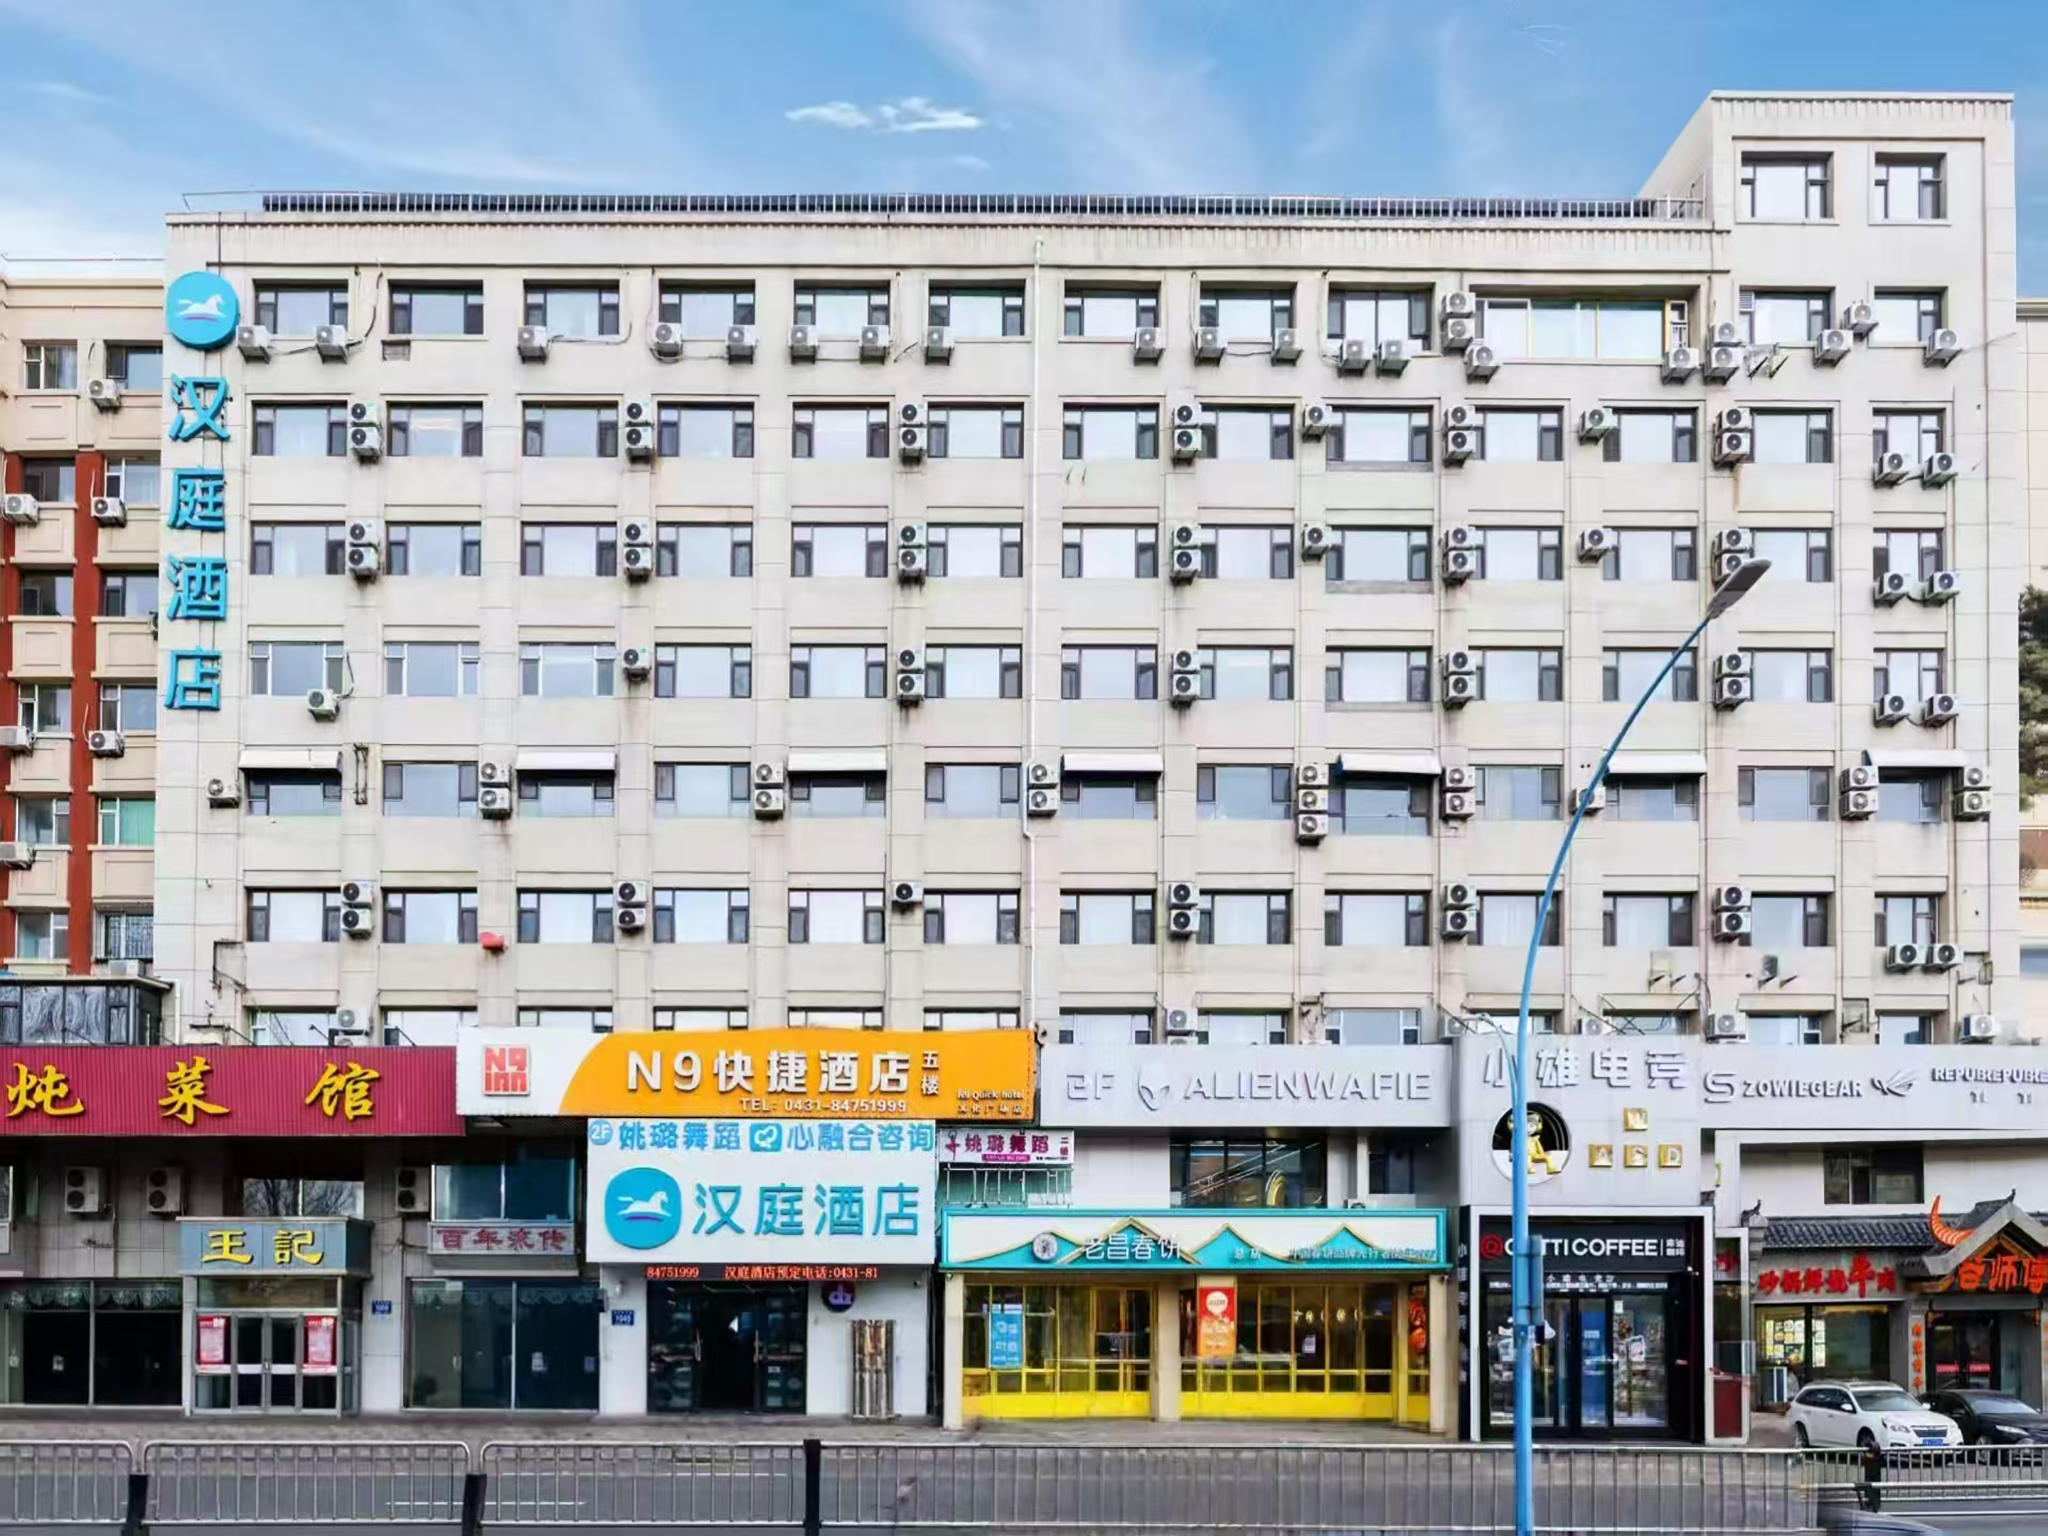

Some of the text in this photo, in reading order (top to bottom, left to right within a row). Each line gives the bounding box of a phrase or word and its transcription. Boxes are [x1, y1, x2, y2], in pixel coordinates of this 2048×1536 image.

[164, 373, 230, 711] 汉庭酒店
[485, 1047, 527, 1071] N9
[626, 1049, 910, 1094] N9快捷酒店
[921, 1051, 939, 1095] 五楼
[6, 1056, 382, 1125] 炖菜馆
[1742, 1078, 1863, 1098] ZOWIEGEAR
[740, 1097, 908, 1113] TEL: 0431-84751999
[591, 1124, 611, 1140] 2F
[619, 1121, 741, 1150] 姚璐舞蹈
[787, 1122, 934, 1152] 心融合咨询
[965, 1134, 1049, 1154] 姚璐舞蹈
[692, 1181, 920, 1237] 汉庭酒店
[201, 1229, 324, 1265] 王記
[1572, 1238, 1657, 1257] COFFEE
[647, 1266, 699, 1279] 84751999
